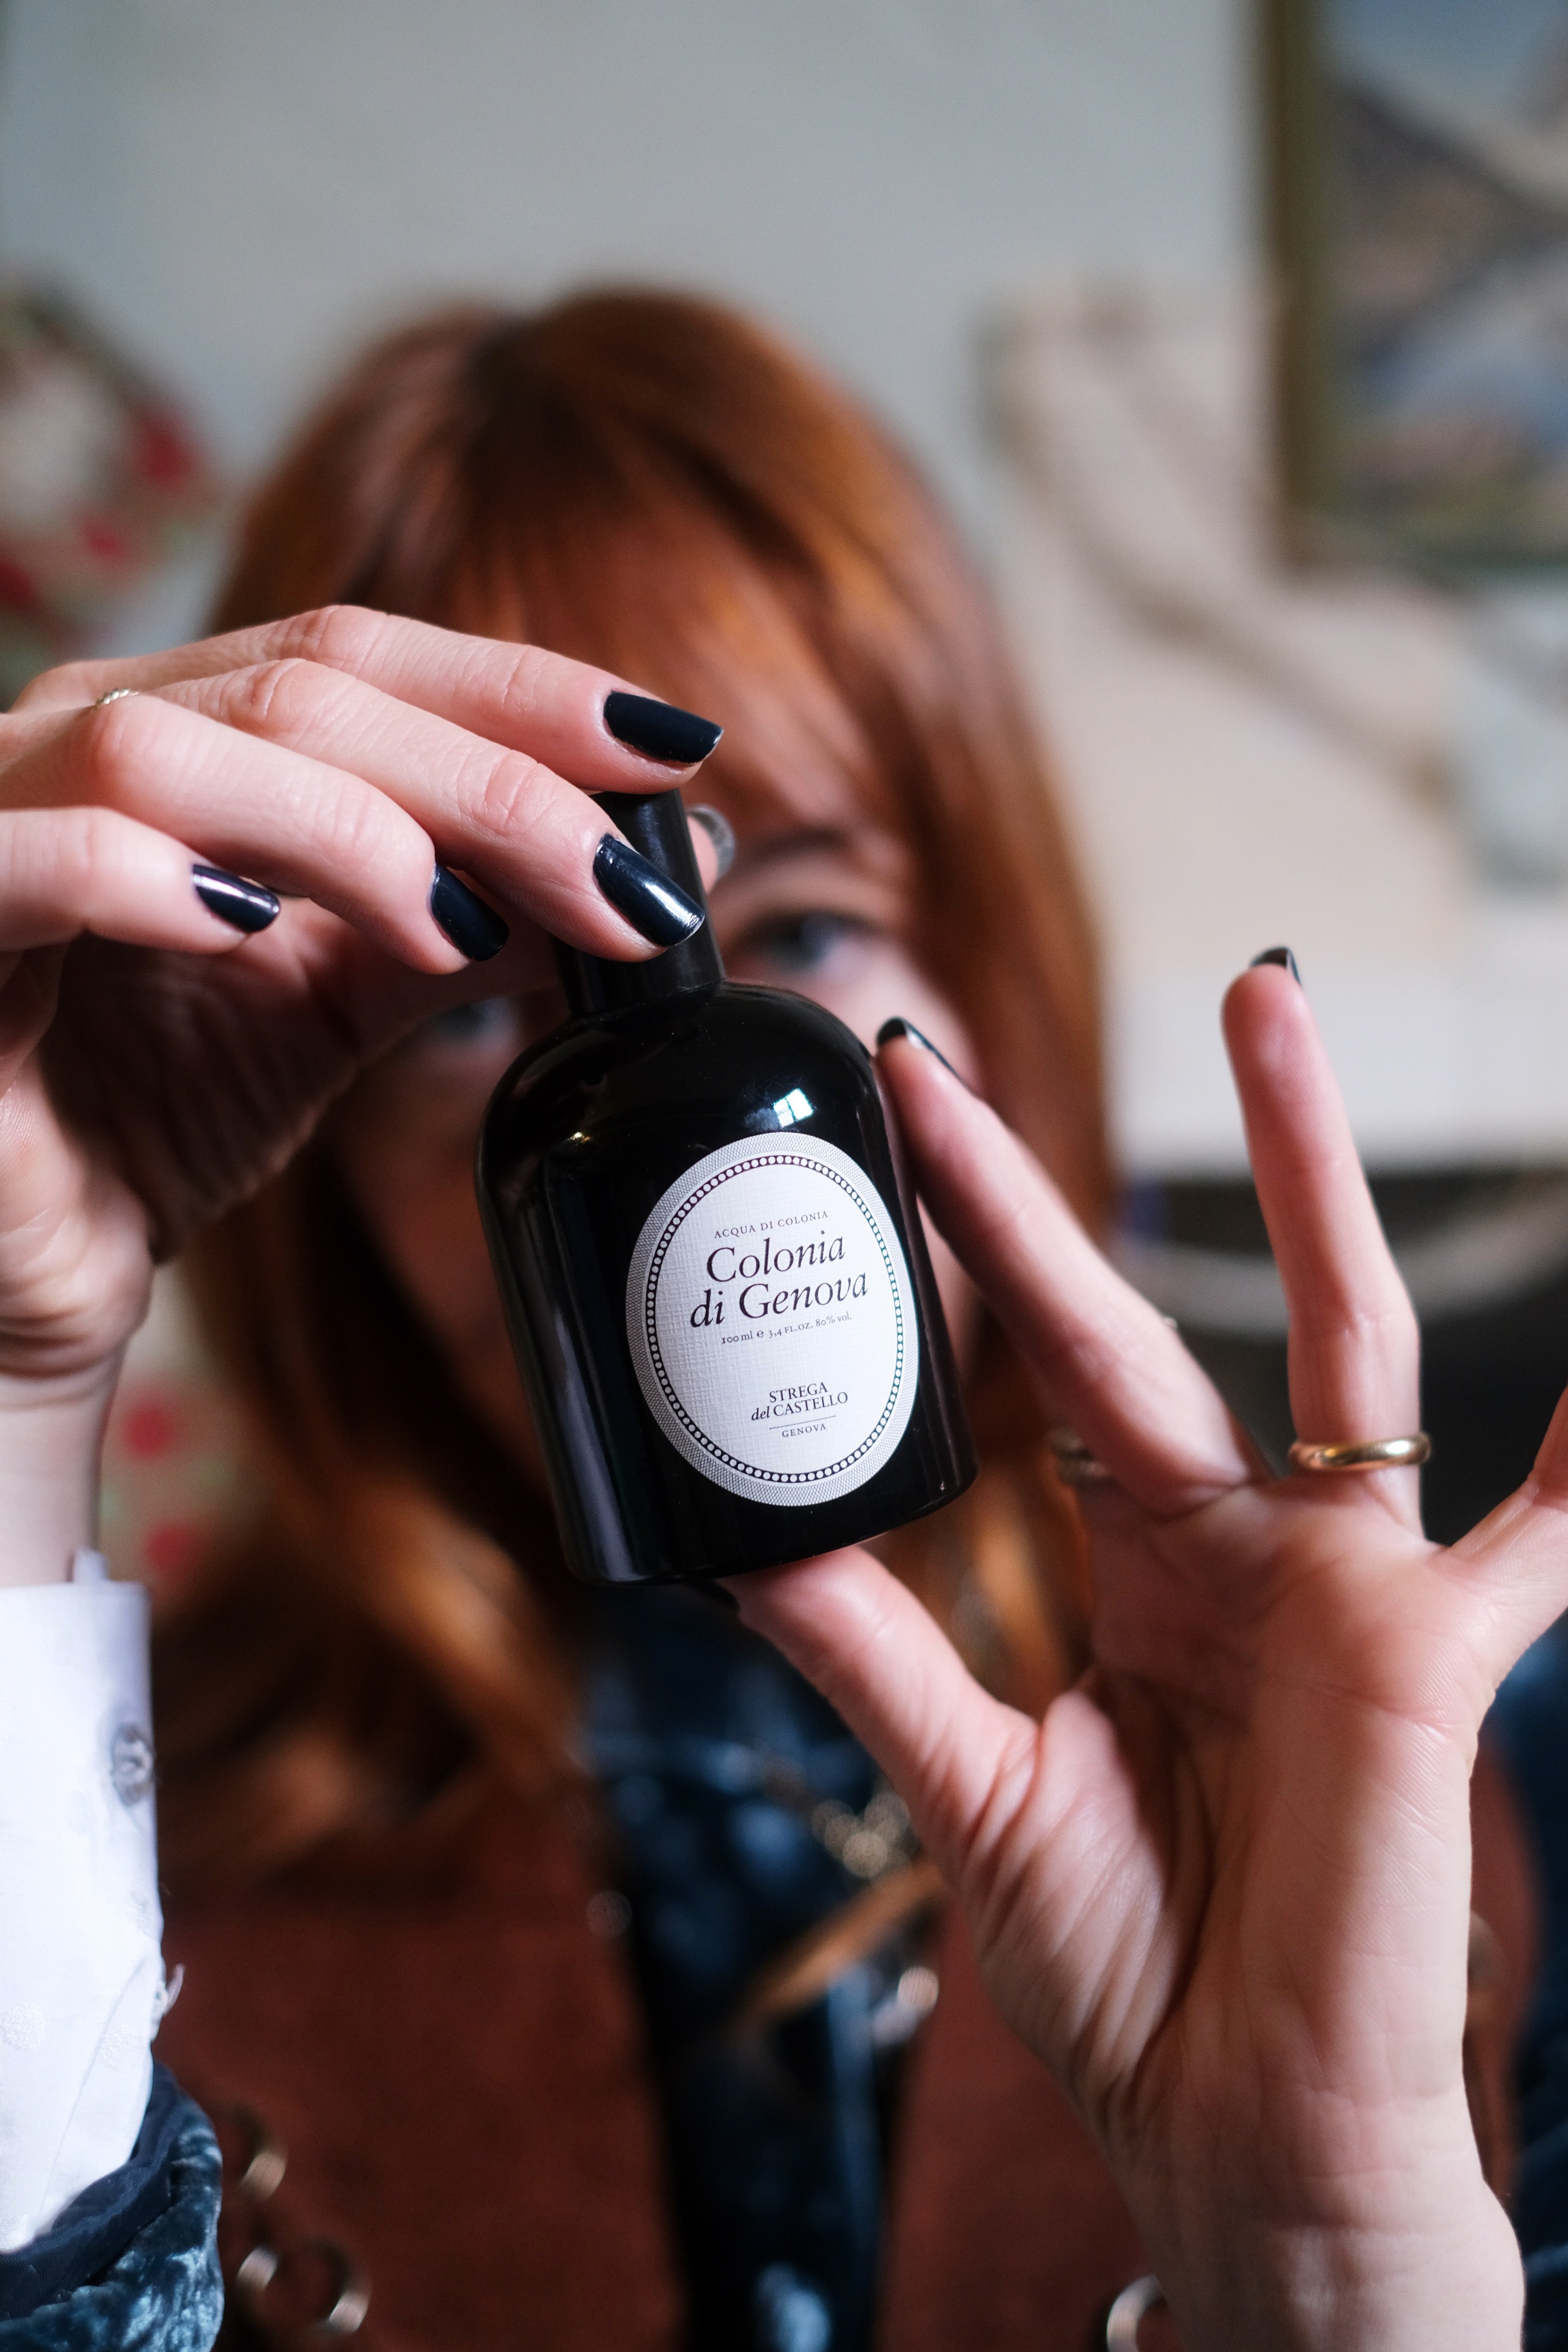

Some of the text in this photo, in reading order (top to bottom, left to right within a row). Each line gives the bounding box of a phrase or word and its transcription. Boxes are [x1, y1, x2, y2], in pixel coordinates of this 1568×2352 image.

[714, 1211, 828, 1238] ACQUA DI COLONIA
[706, 1230, 846, 1282] Colonia
[690, 1272, 868, 1328] di Genova
[768, 1329, 782, 1339] 3,4
[815, 1315, 835, 1327] 80%
[837, 1311, 852, 1322] vol.
[769, 1381, 828, 1403] STREGA
[751, 1392, 848, 1421] del CASTELLO
[781, 1423, 827, 1437] GENOVA
